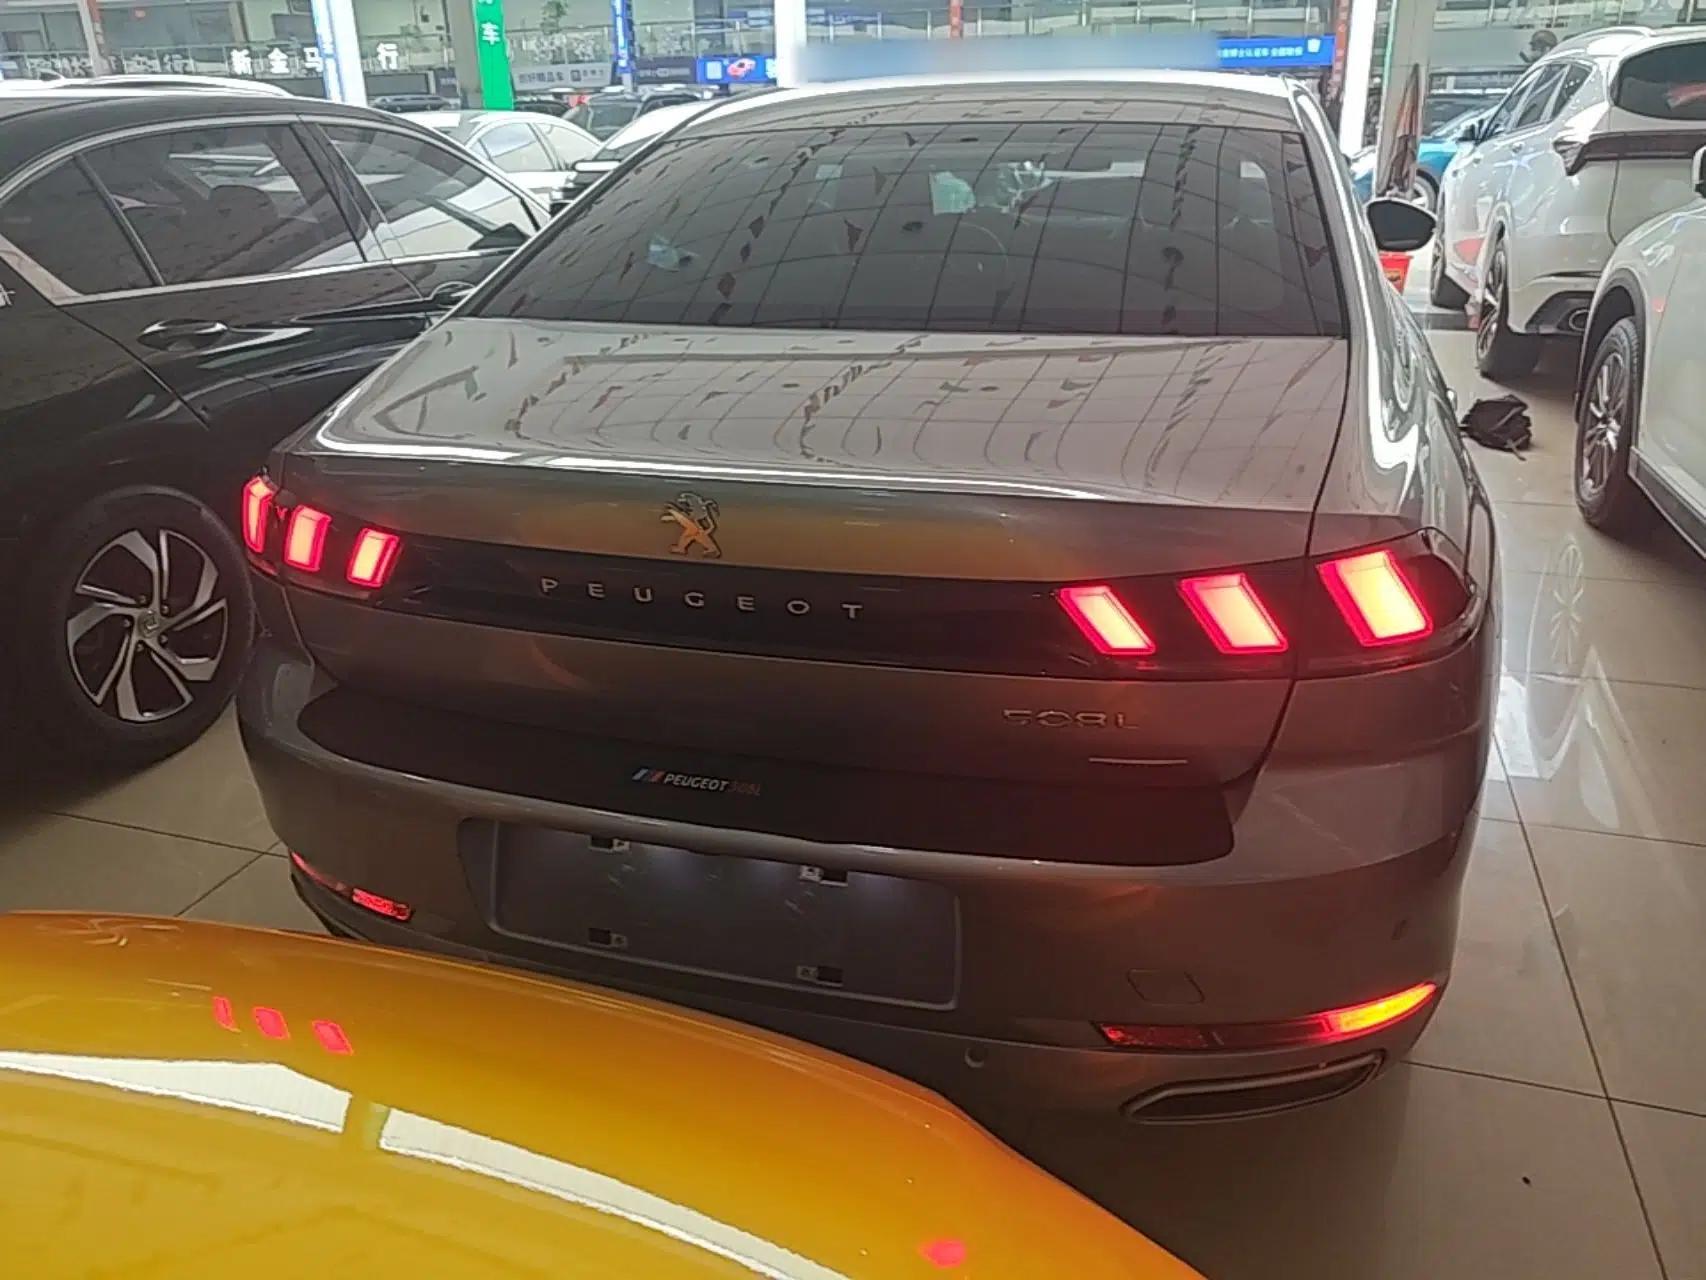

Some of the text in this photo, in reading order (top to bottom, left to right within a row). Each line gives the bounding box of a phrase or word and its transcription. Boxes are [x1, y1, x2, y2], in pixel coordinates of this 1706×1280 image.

[230, 42, 399, 75] 新金马行
[541, 577, 864, 620] PEUGEOT
[1002, 708, 1140, 730] 508L
